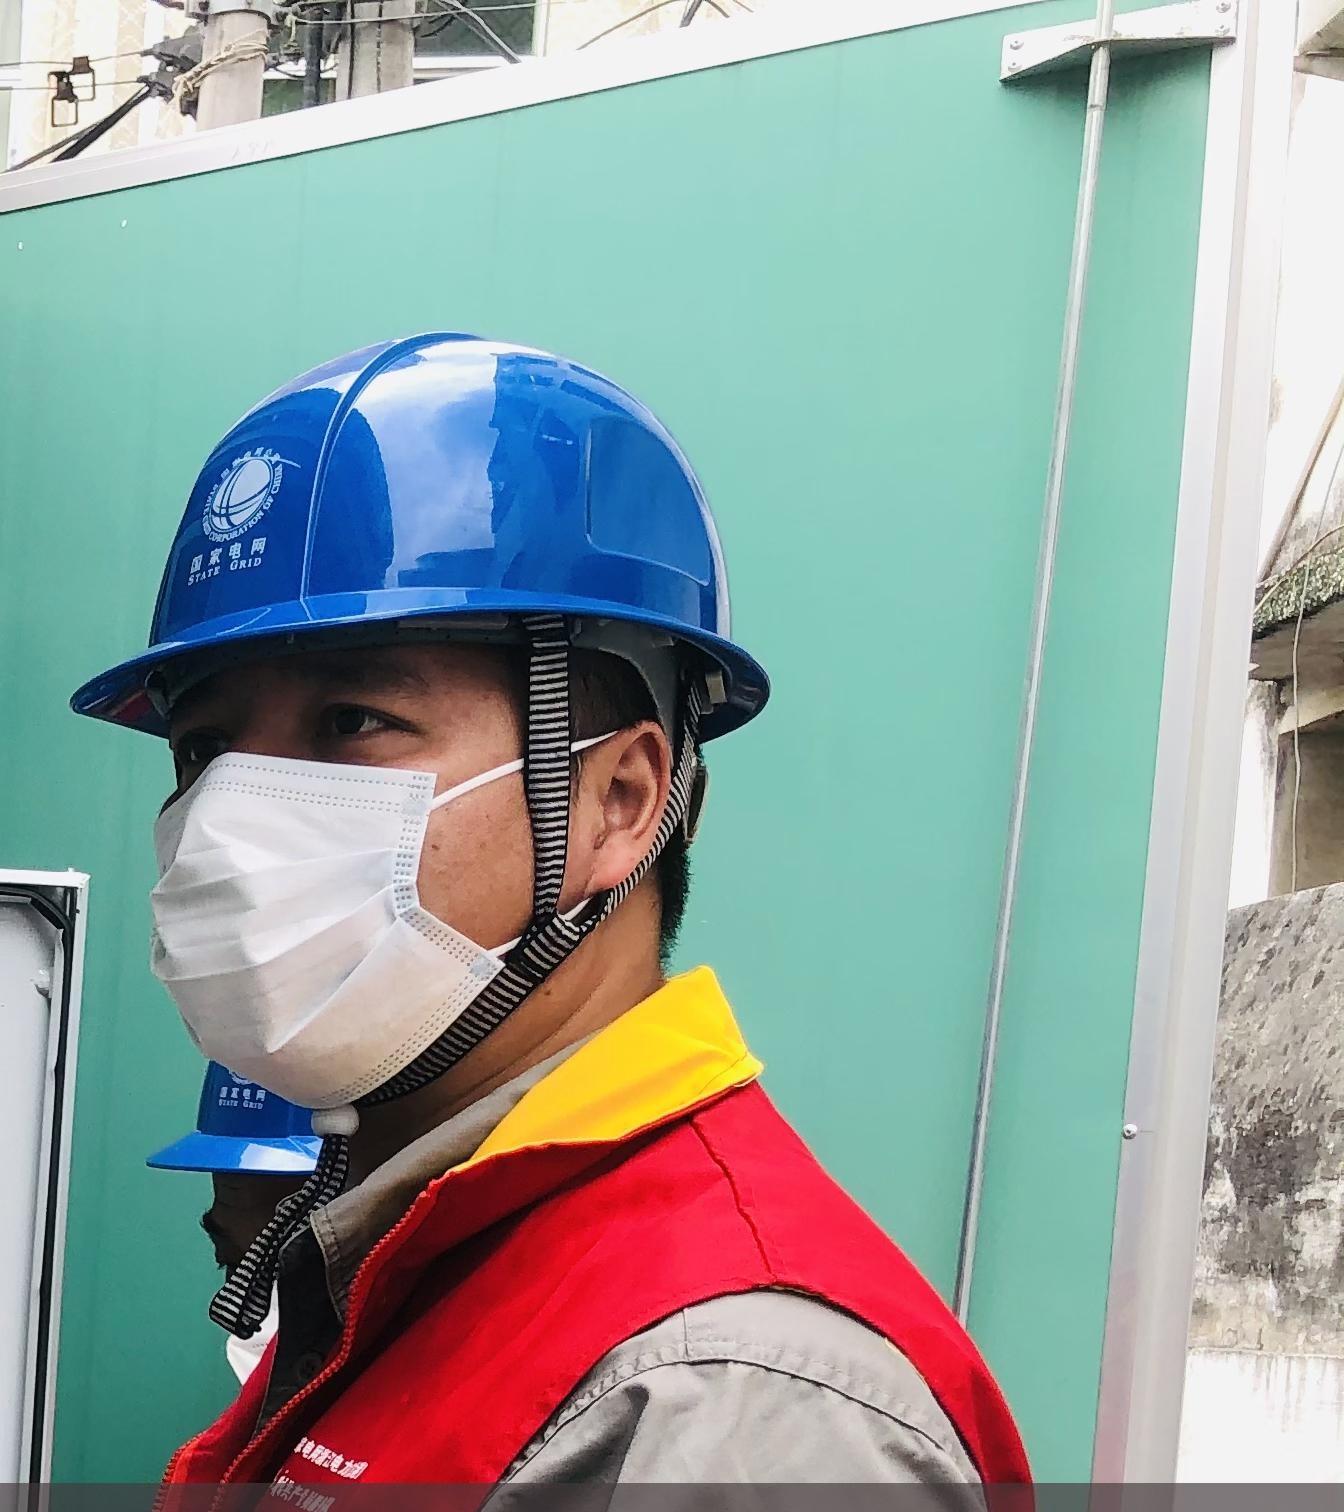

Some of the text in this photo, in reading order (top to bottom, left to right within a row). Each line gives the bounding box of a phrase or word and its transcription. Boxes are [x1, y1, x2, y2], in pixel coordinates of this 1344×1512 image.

[187, 556, 262, 586] STATE GRID
[189, 536, 267, 574] 国家电网
